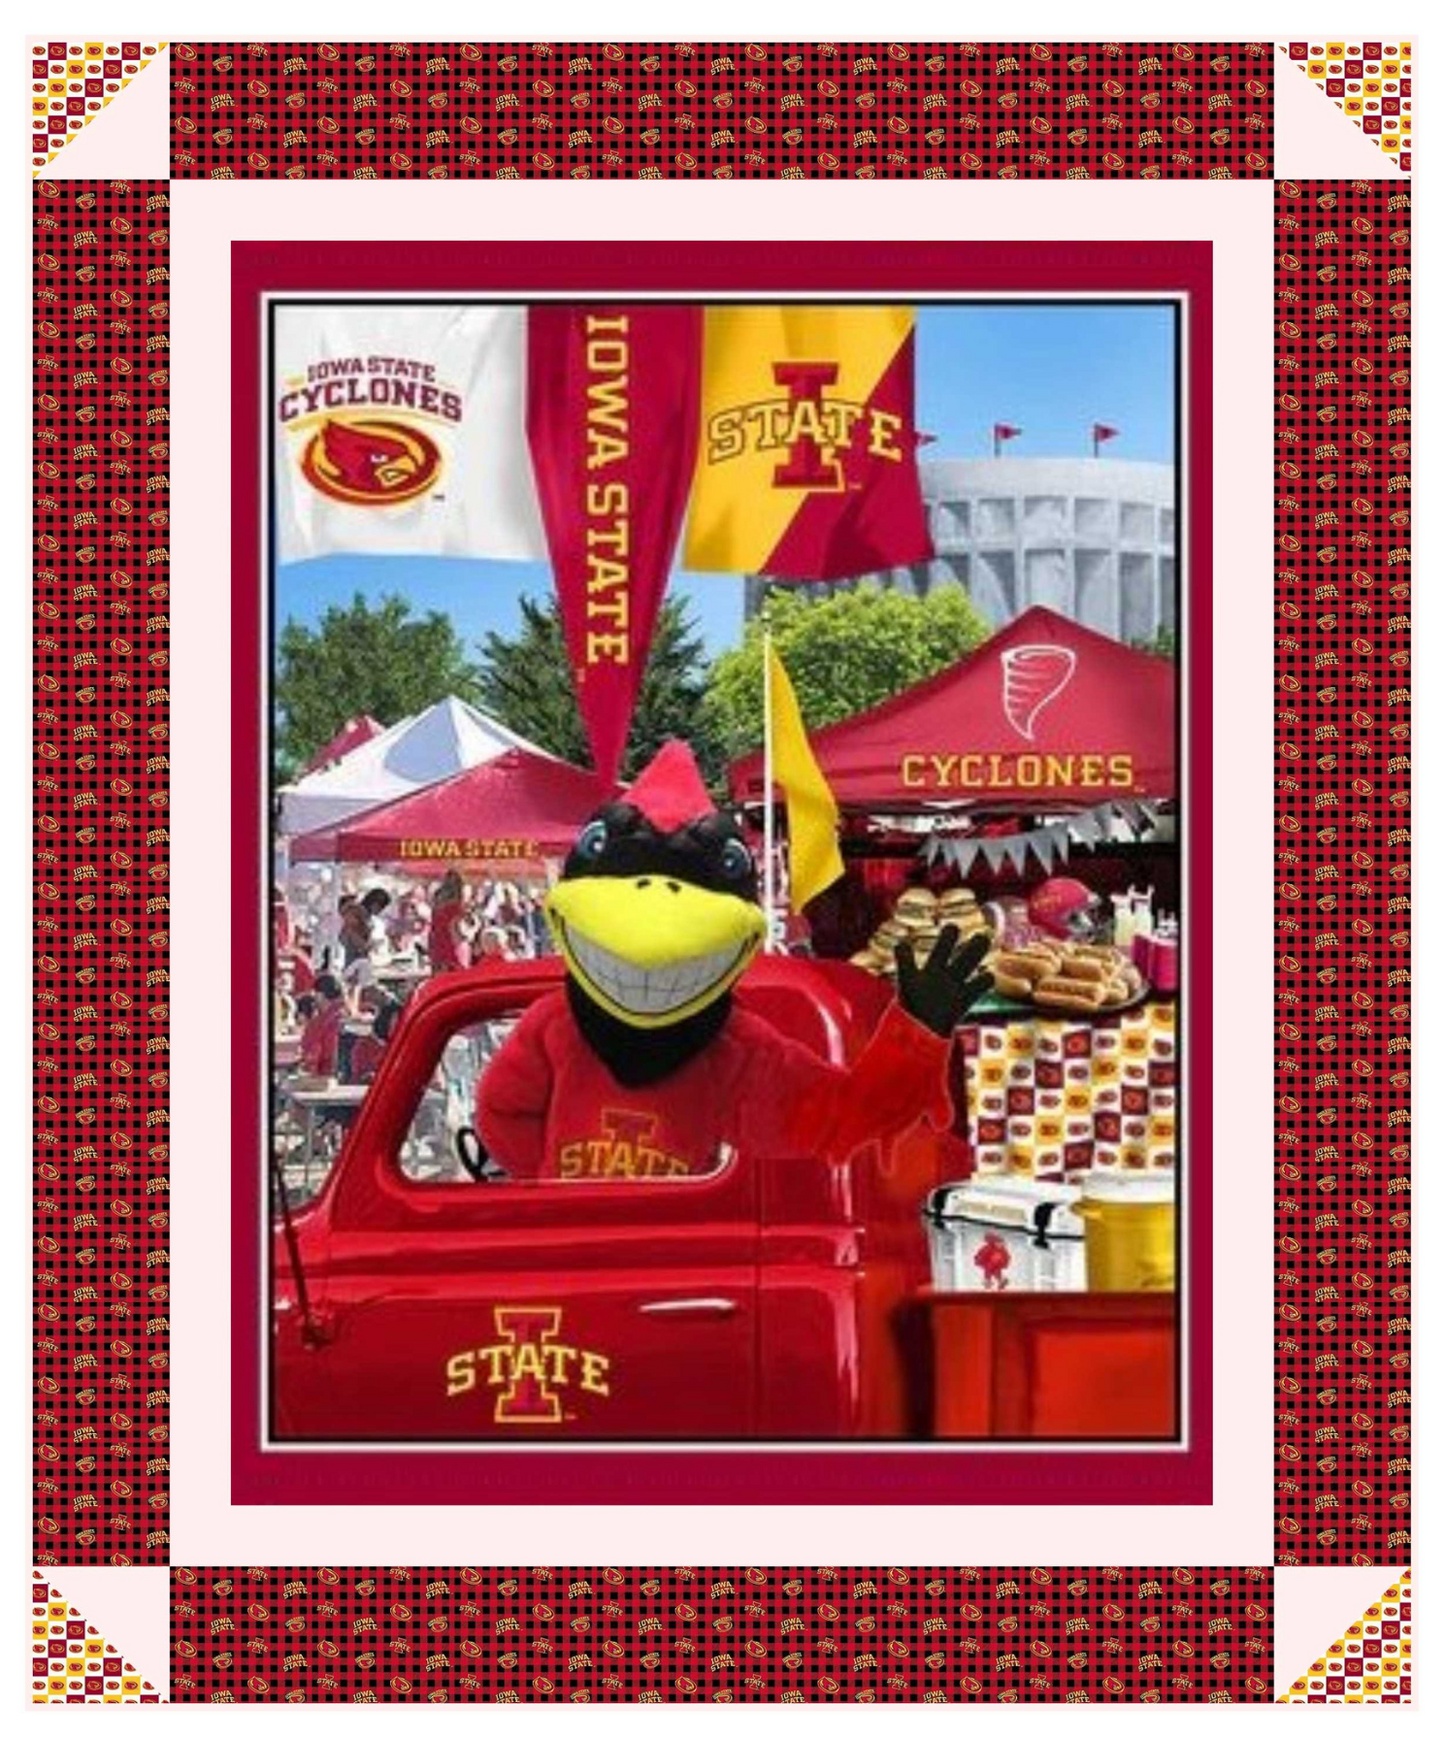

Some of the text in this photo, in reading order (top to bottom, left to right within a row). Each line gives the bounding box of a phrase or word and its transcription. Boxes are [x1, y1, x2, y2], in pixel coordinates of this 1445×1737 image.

[283, 57, 305, 68] IOWA
[426, 57, 448, 68] IOWA
[568, 57, 590, 68] IOWA
[710, 57, 732, 68] IOWA
[853, 57, 875, 68] IOWA
[995, 57, 1017, 68] IOWA
[283, 64, 309, 76] STATE
[426, 64, 452, 76] STATE
[568, 64, 594, 76] STATE
[710, 64, 736, 76] STATE
[853, 64, 879, 76] STATE
[995, 64, 1021, 76] STATE
[210, 93, 232, 104] IOWA
[352, 93, 374, 104] IOWA
[922, 93, 944, 104] IOWA
[1066, 93, 1087, 104] IOWA
[1208, 93, 1229, 104] IOWA
[210, 100, 236, 112] STATE
[352, 100, 378, 112] STATE
[922, 100, 948, 112] STATE
[1065, 100, 1090, 112] STATE
[1207, 100, 1232, 112] STATE
[568, 130, 590, 141] IOWA
[710, 130, 732, 141] IOWA
[1138, 130, 1160, 141] IOWA
[568, 137, 594, 149] STATE
[710, 137, 736, 149] STATE
[1138, 137, 1164, 149] STATE
[74, 303, 95, 314] IOWA
[1314, 303, 1336, 314] IOWA
[73, 310, 98, 322] STATE
[1314, 310, 1340, 322] STATE
[308, 356, 435, 383] IOWA STATE
[74, 371, 95, 382] IOWA
[73, 378, 98, 390] STATE
[279, 379, 462, 422] CYCLONES
[708, 399, 903, 466] STATE
[1314, 443, 1336, 454] IOWA
[1314, 450, 1340, 462] STATE
[587, 315, 630, 664] IOWA STATE
[74, 511, 95, 522] IOWA
[1314, 511, 1336, 522] IOWA
[73, 518, 98, 530] STATE
[1314, 518, 1340, 530] STATE
[74, 651, 95, 662] IOWA
[1314, 651, 1336, 662] IOWA
[73, 658, 98, 670] STATE
[1314, 658, 1340, 670] STATE
[74, 724, 95, 736] IOWA
[73, 731, 98, 743] STATE
[903, 754, 1132, 788] CYCLONES
[1314, 792, 1336, 804] IOWA
[1314, 799, 1340, 811] STATE
[401, 840, 539, 857] IOWA STATE
[74, 864, 95, 876] IOWA
[1314, 864, 1336, 876] IOWA
[73, 871, 98, 883] STATE
[1314, 871, 1340, 883] STATE
[74, 932, 95, 944] IOWA
[73, 939, 98, 951] STATE
[1314, 1005, 1336, 1016] IOWA
[1314, 1012, 1340, 1024] STATE
[74, 1072, 95, 1084] IOWA
[73, 1079, 98, 1091] STATE
[74, 1145, 95, 1156] IOWA
[1314, 1145, 1336, 1156] IOWA
[73, 1152, 98, 1164] STATE
[1314, 1152, 1340, 1164] STATE
[1314, 1213, 1336, 1224] IOWA
[1314, 1220, 1340, 1232] STATE
[74, 1285, 95, 1296] IOWA
[73, 1292, 98, 1304] STATE
[1314, 1353, 1336, 1364] IOWA
[446, 1342, 611, 1397] STATE
[1314, 1360, 1340, 1372] STATE
[74, 1426, 95, 1438] IOWA
[73, 1433, 98, 1445] STATE
[74, 1494, 95, 1506] IOWA
[1314, 1494, 1336, 1506] IOWA
[73, 1501, 98, 1513] STATE
[1314, 1501, 1340, 1513] STATE
[283, 1581, 305, 1592] IOWA
[426, 1581, 448, 1592] IOWA
[853, 1581, 875, 1592] IOWA
[995, 1581, 1017, 1592] IOWA
[283, 1588, 309, 1600] STATE
[426, 1588, 452, 1600] STATE
[853, 1588, 879, 1600] STATE
[995, 1588, 1021, 1600] STATE
[354, 1617, 375, 1628] IOWA
[496, 1617, 517, 1628] IOWA
[638, 1617, 659, 1628] IOWA
[780, 1617, 802, 1628] IOWA
[1208, 1617, 1229, 1628] IOWA
[353, 1624, 378, 1636] STATE
[495, 1624, 520, 1636] STATE
[637, 1624, 662, 1636] STATE
[780, 1624, 806, 1636] STATE
[1207, 1624, 1232, 1636] STATE
[568, 1654, 590, 1665] IOWA
[710, 1654, 732, 1665] IOWA
[995, 1654, 1017, 1665] IOWA
[1138, 1654, 1160, 1665] IOWA
[568, 1661, 594, 1673] STATE
[710, 1661, 736, 1673] STATE
[995, 1661, 1021, 1673] STATE
[1138, 1661, 1164, 1673] STATE
